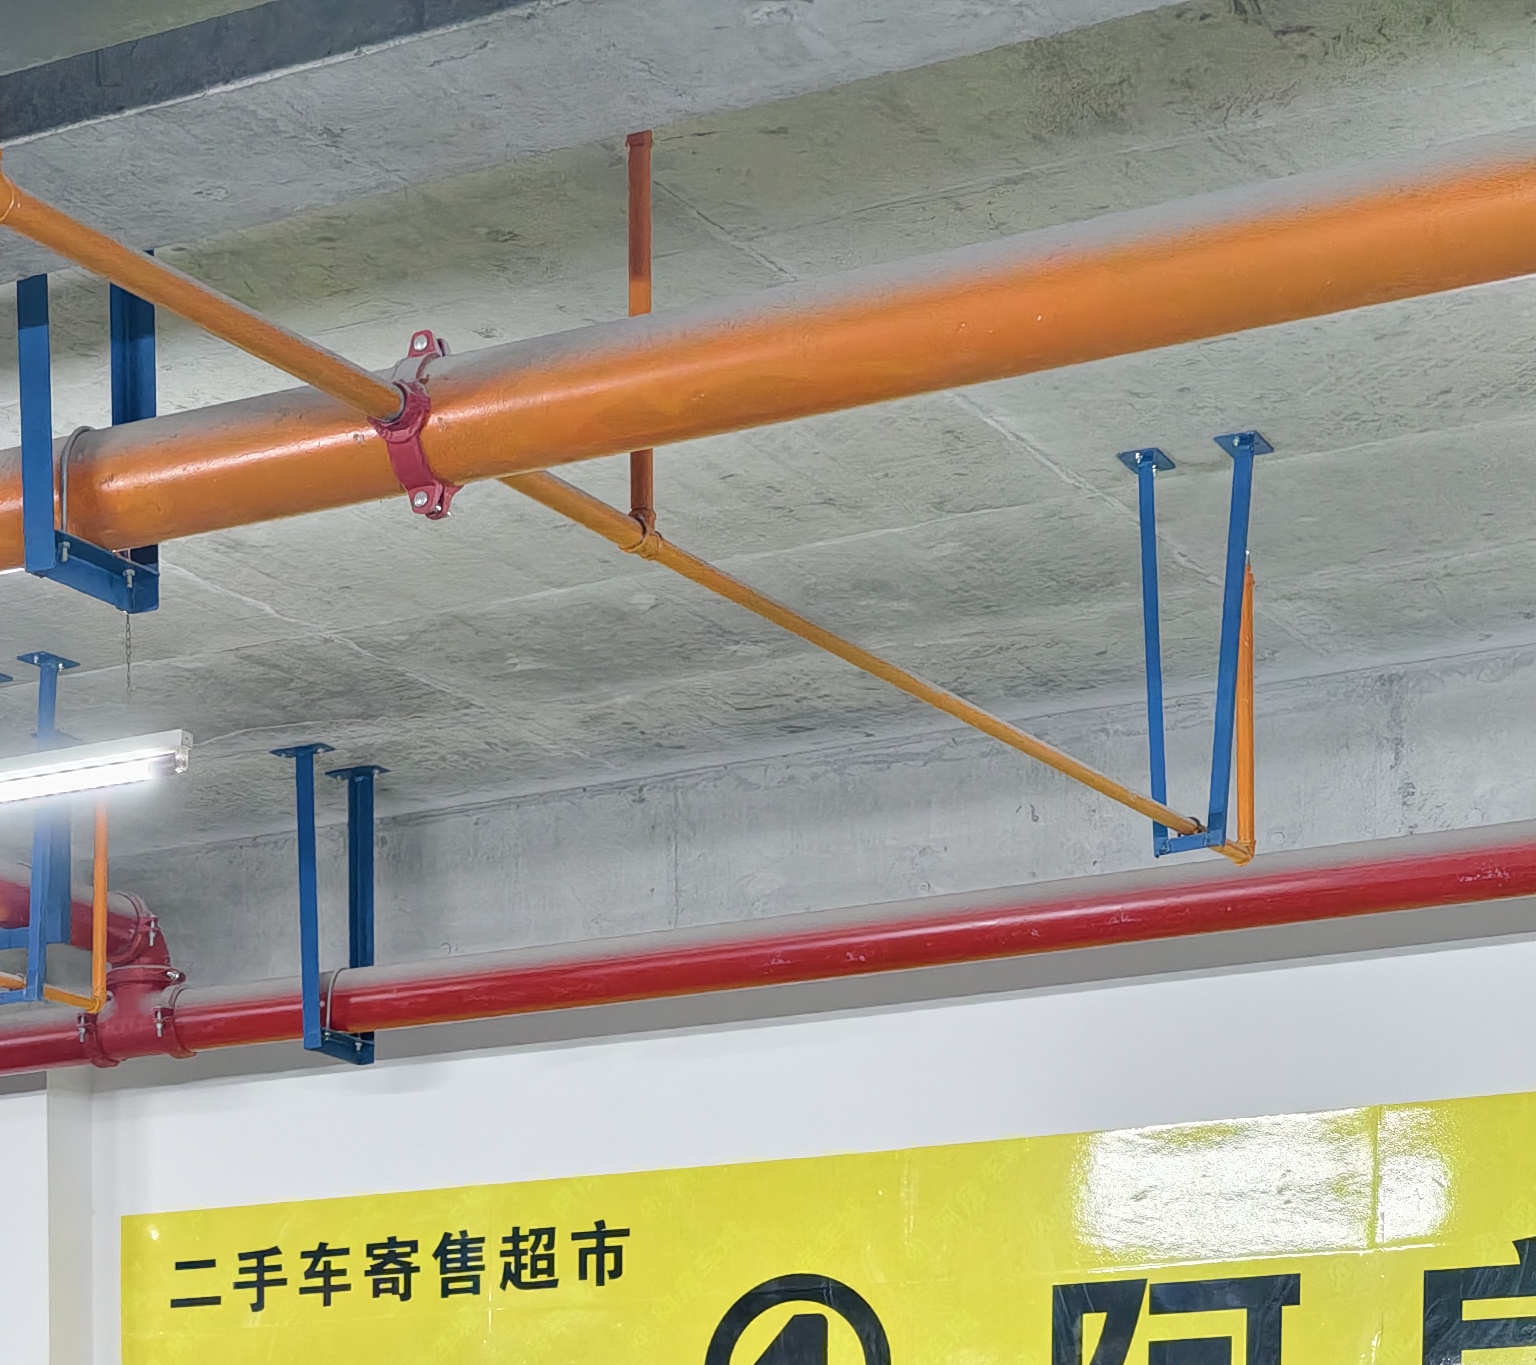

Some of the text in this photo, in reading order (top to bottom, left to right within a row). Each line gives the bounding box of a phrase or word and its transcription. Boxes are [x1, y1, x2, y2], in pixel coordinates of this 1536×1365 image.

[170, 1219, 631, 1313] 二手车寄售超市
